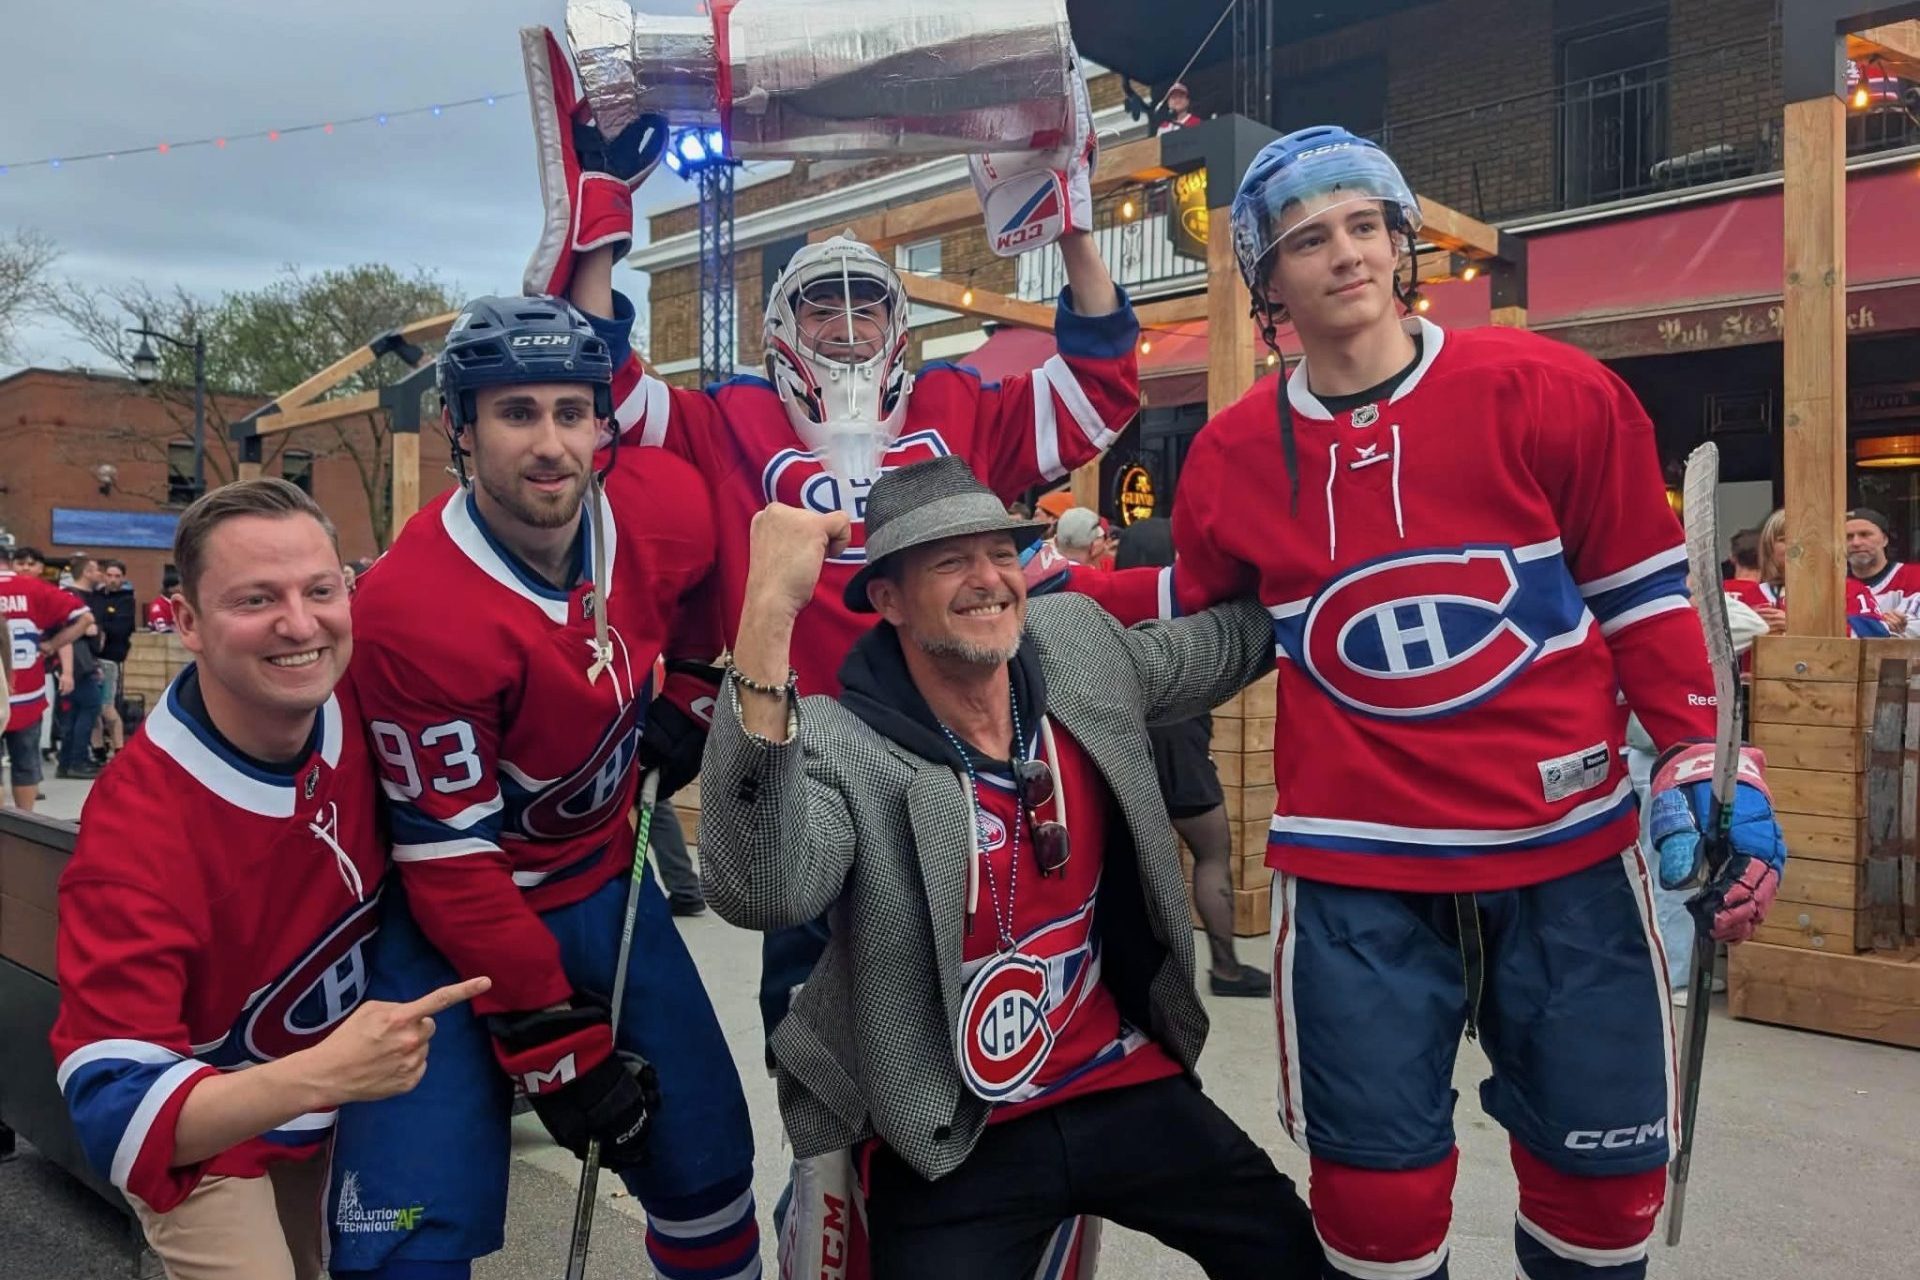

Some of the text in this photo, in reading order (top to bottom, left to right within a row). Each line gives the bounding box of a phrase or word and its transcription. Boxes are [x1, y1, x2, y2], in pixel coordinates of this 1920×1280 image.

[997, 223, 1043, 250] CCM
[512, 335, 571, 347] CCM
[1657, 318, 1709, 347] Pub
[1687, 693, 1718, 706] Ree
[370, 719, 482, 799] 93
[1564, 1116, 1666, 1150] CCM
[821, 1192, 846, 1280] CM
